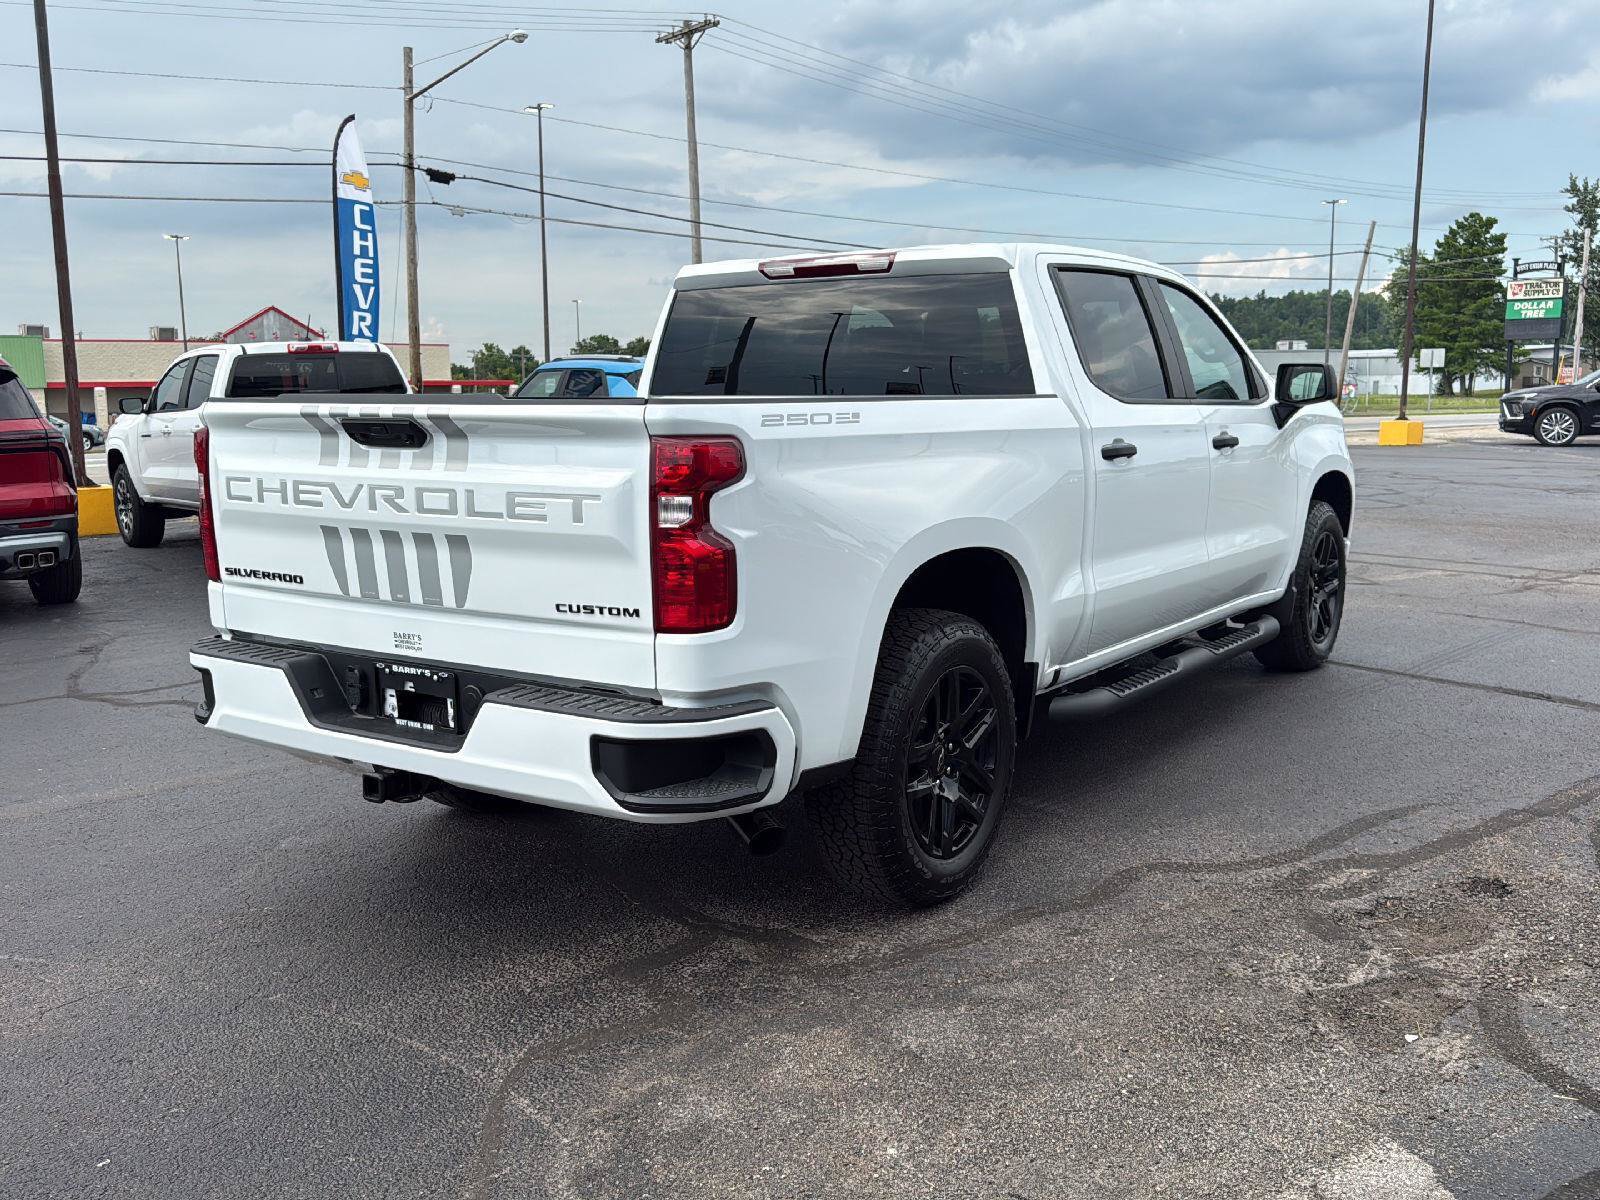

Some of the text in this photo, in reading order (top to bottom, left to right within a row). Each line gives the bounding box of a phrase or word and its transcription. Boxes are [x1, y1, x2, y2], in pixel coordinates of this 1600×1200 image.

[1524, 281, 1560, 289] TRACTOR
[1523, 289, 1550, 297] SUPPLY
[1513, 301, 1554, 310] DOLLAR
[1521, 310, 1546, 319] TREE
[225, 476, 602, 525] CHEVROLET
[224, 567, 304, 584] SILVERADO
[555, 603, 640, 618] CUSTOM
[393, 631, 422, 641] BARRY'S
[392, 664, 431, 677] BARRY'S
